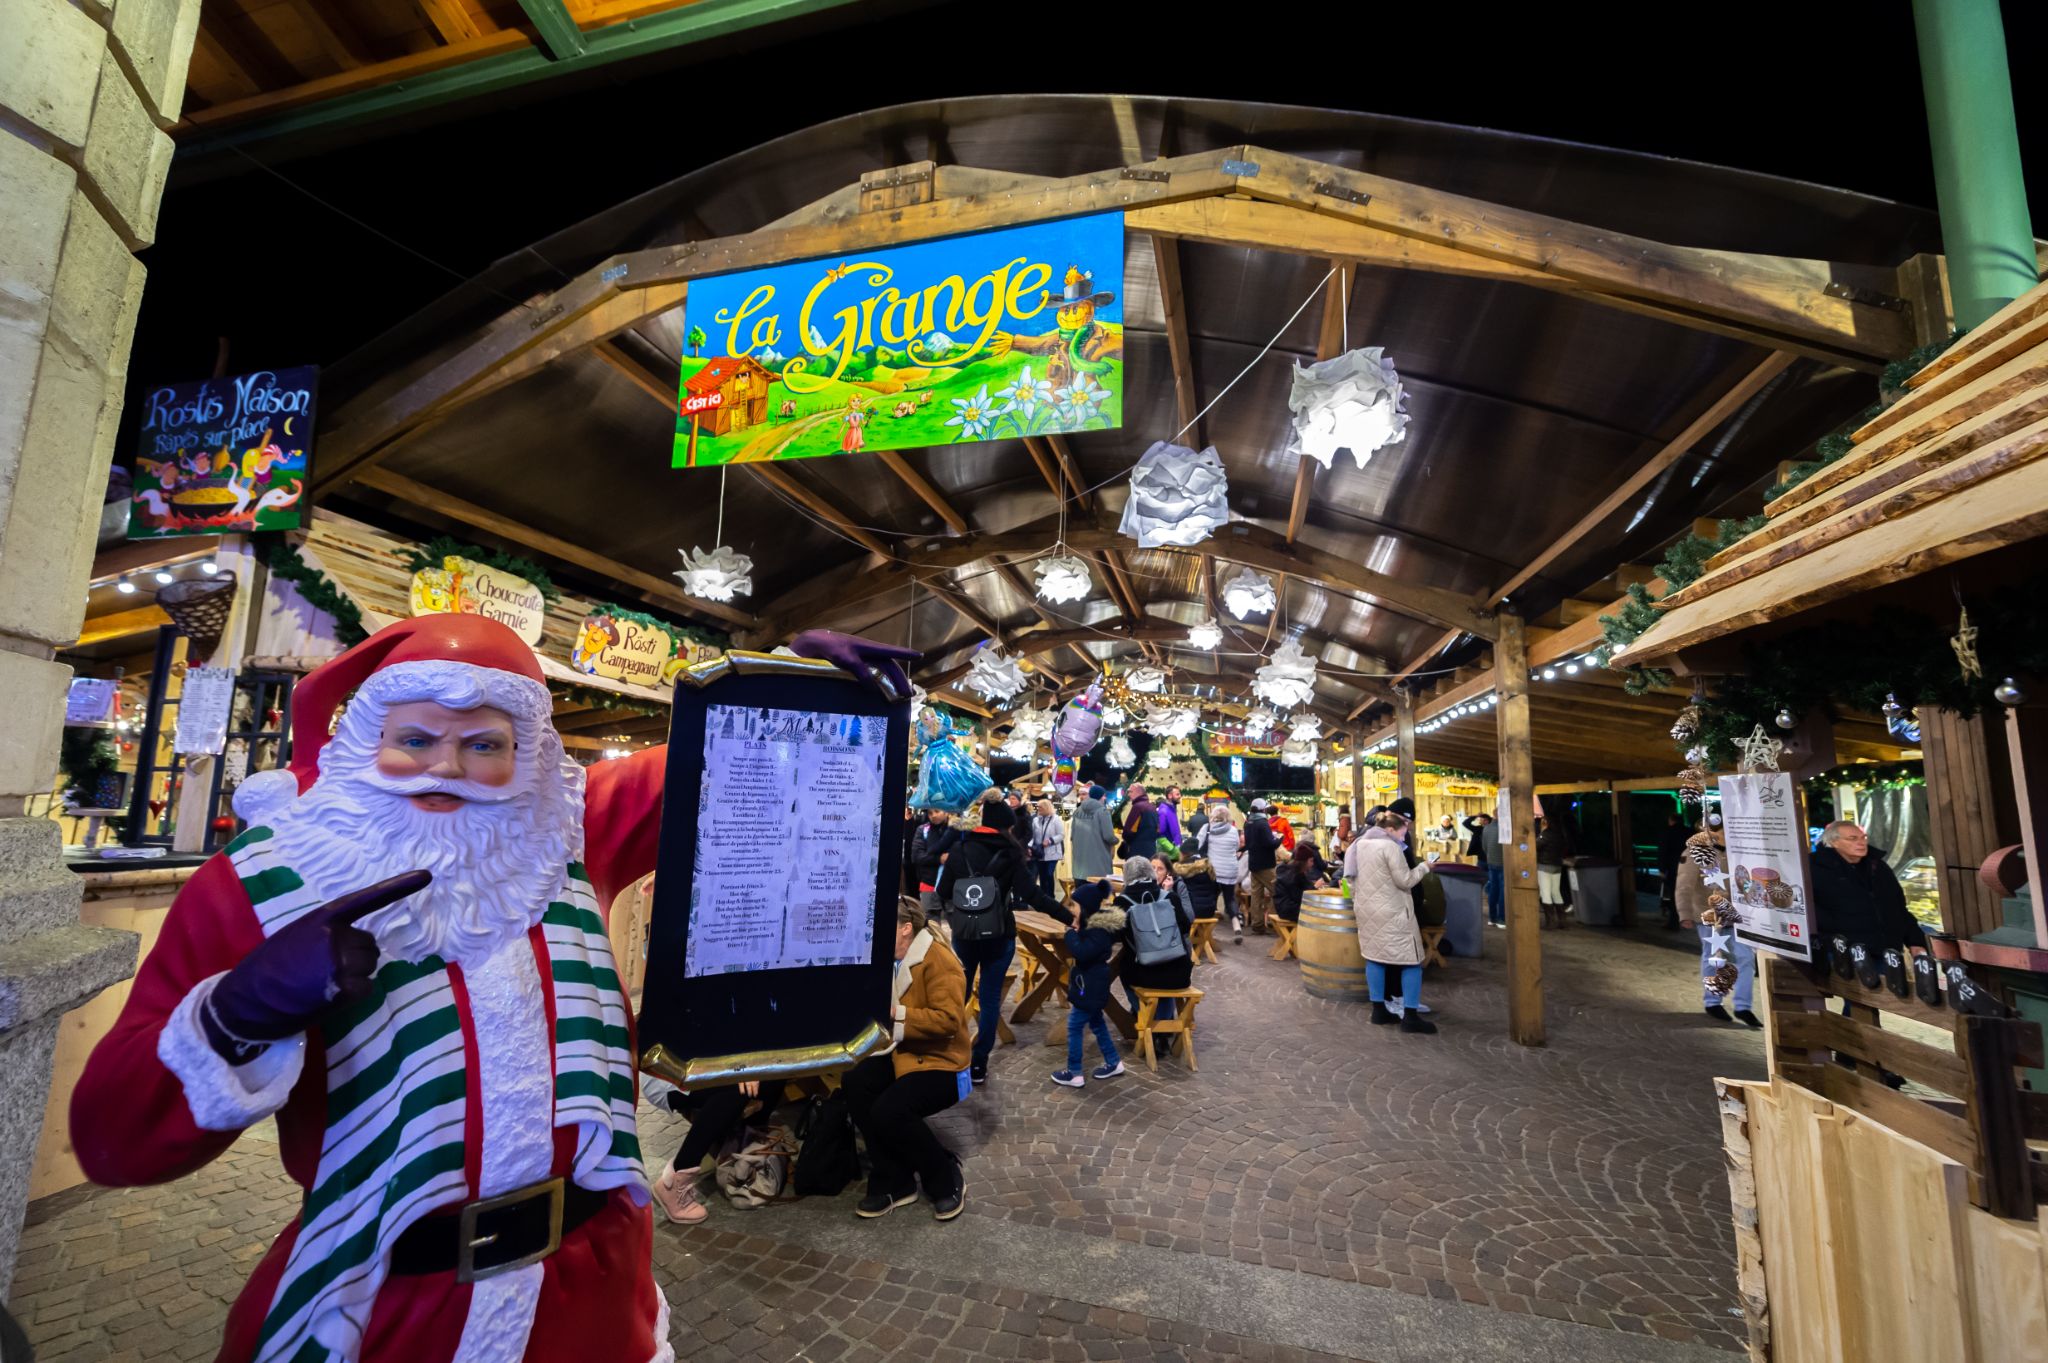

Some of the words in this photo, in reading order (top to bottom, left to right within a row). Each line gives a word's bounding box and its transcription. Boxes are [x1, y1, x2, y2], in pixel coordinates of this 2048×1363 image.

[782, 257, 1053, 394] Grange
[224, 371, 310, 438] Maison
[203, 430, 229, 449] sur
[228, 416, 271, 451] place
[476, 574, 543, 611] Choucroute
[480, 600, 528, 631] Garnie
[623, 626, 658, 655] Rösti
[599, 645, 661, 676] Campagnard
[744, 741, 766, 749] PLATS
